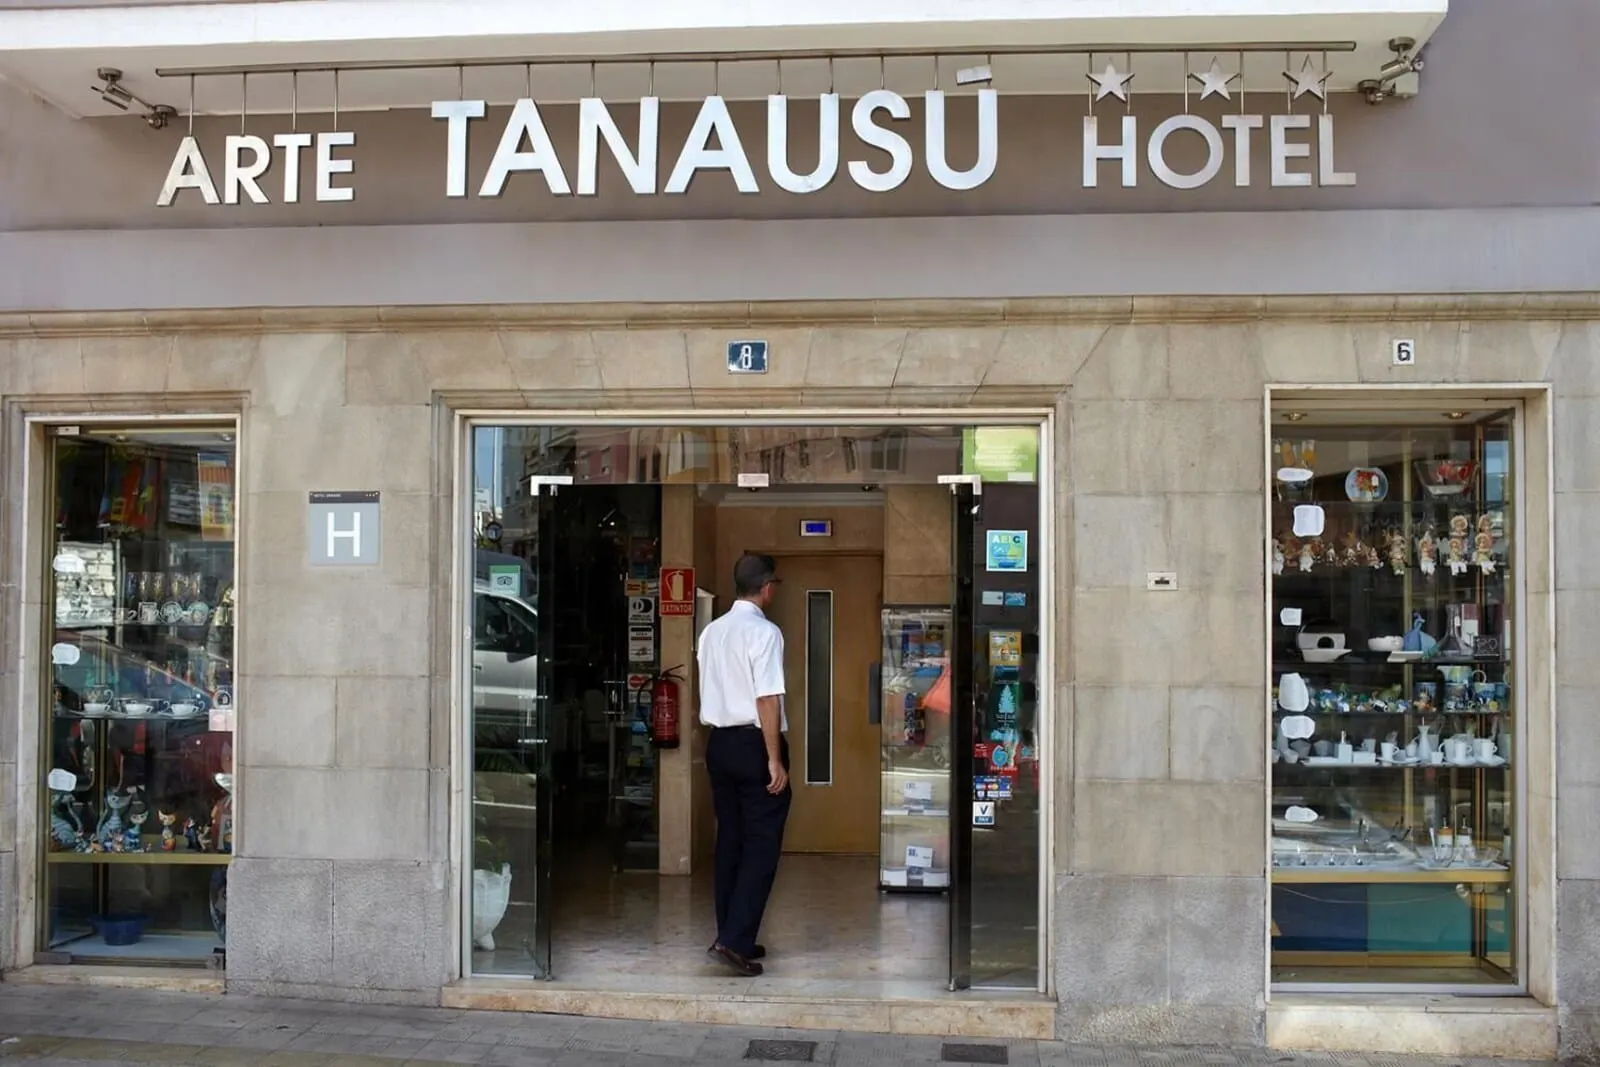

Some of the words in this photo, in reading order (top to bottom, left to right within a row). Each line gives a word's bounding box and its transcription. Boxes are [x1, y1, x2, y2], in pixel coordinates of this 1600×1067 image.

[156, 132, 355, 205] ARTE
[431, 65, 998, 197] TANAUSÚ
[1083, 113, 1357, 189] HOTEL
[741, 344, 752, 369] 8
[1397, 342, 1411, 361] 6
[327, 512, 361, 557] H
